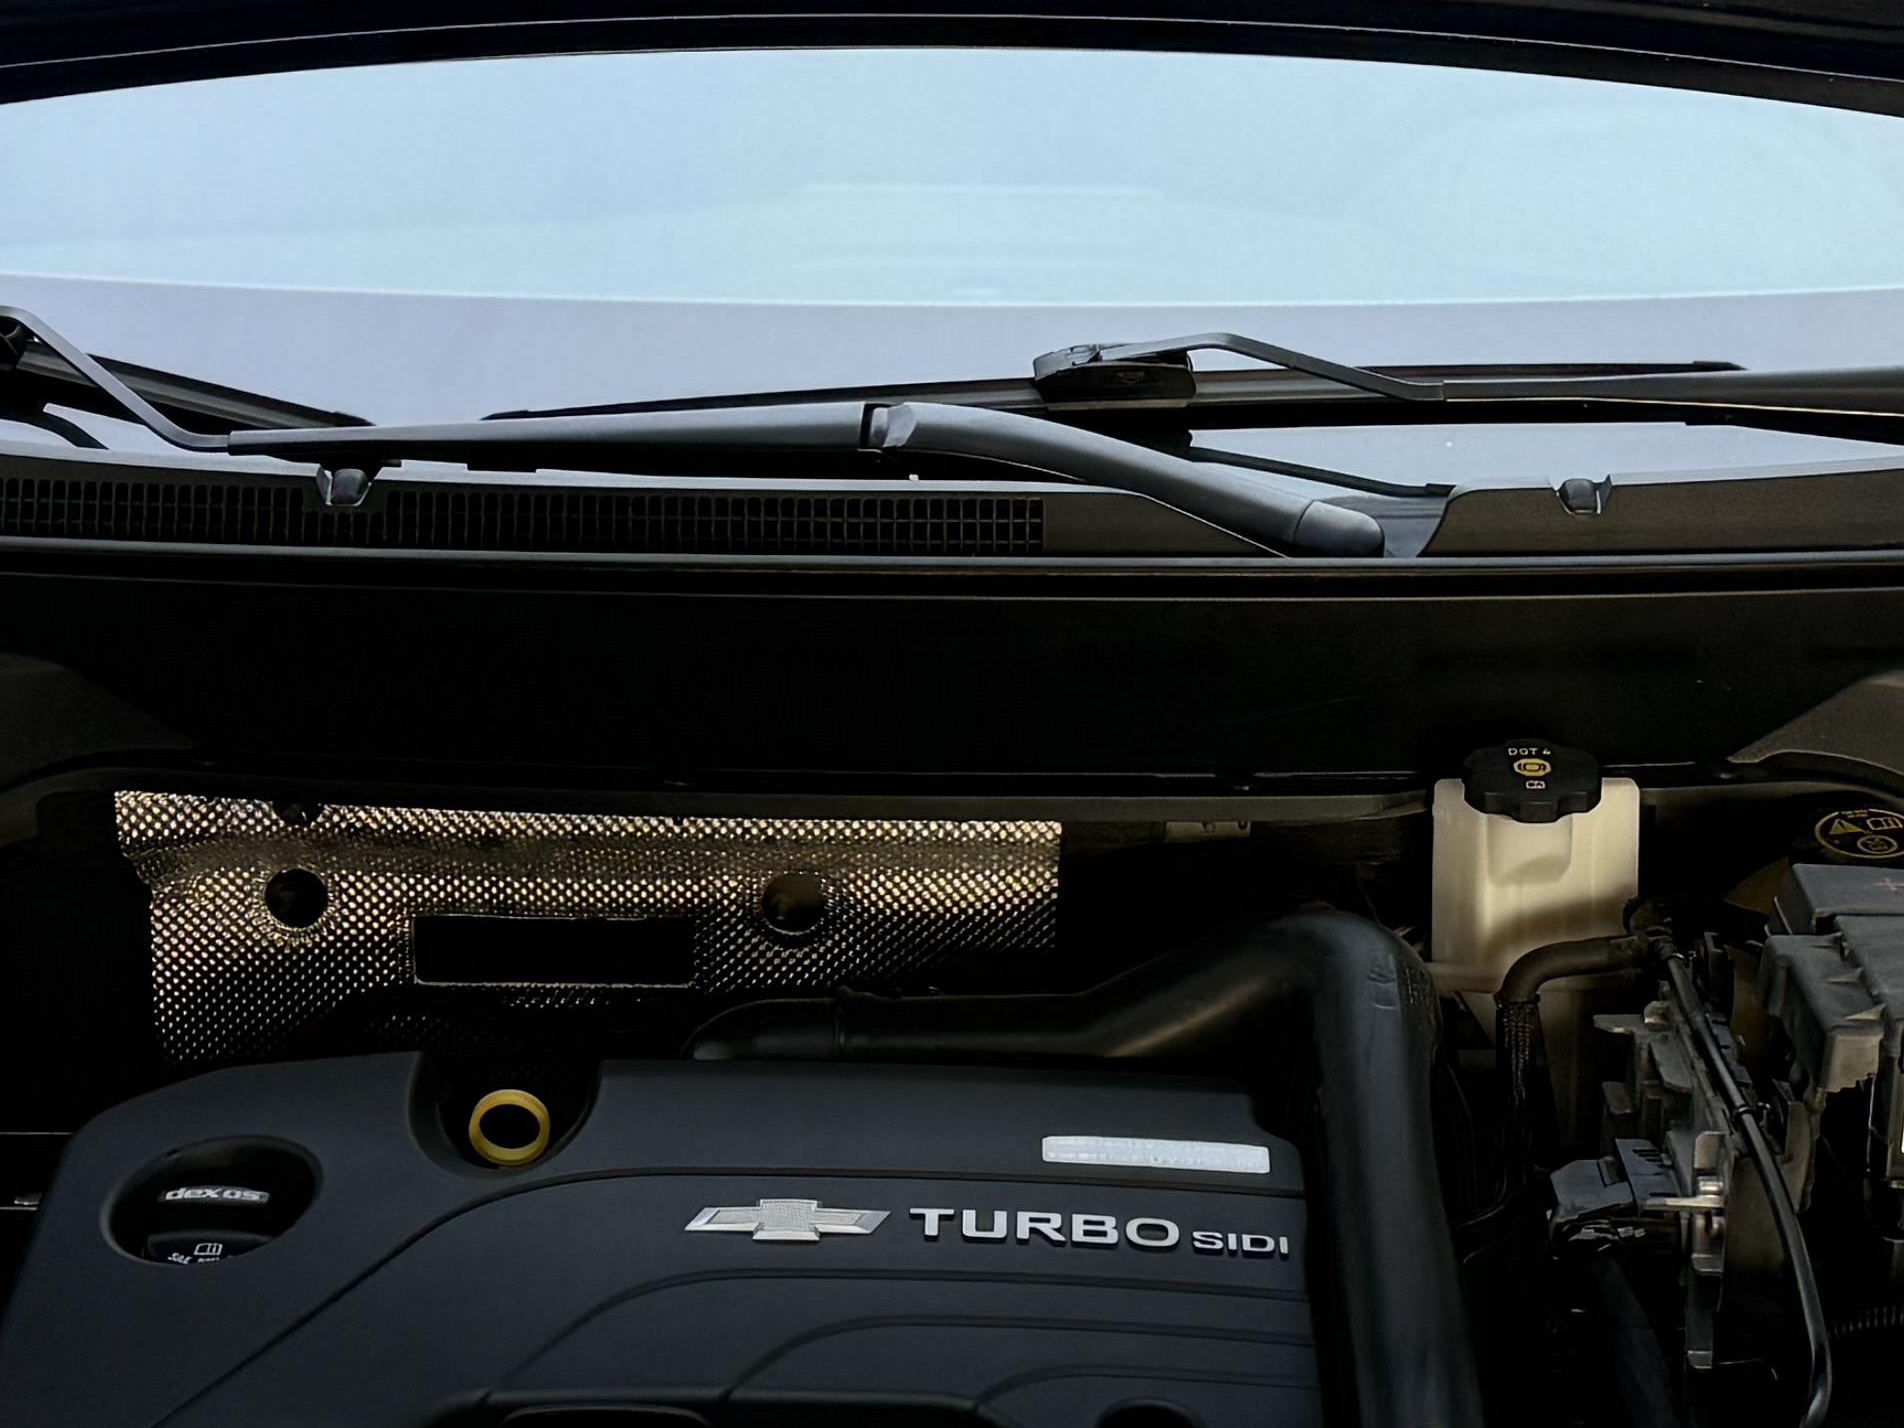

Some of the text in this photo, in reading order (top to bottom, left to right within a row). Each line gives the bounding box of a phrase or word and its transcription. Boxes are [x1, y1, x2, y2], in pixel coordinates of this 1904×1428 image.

[1508, 748, 1538, 756] DOT
[165, 1187, 260, 1201] dexos
[909, 1207, 1289, 1255] TURBO SIDI
